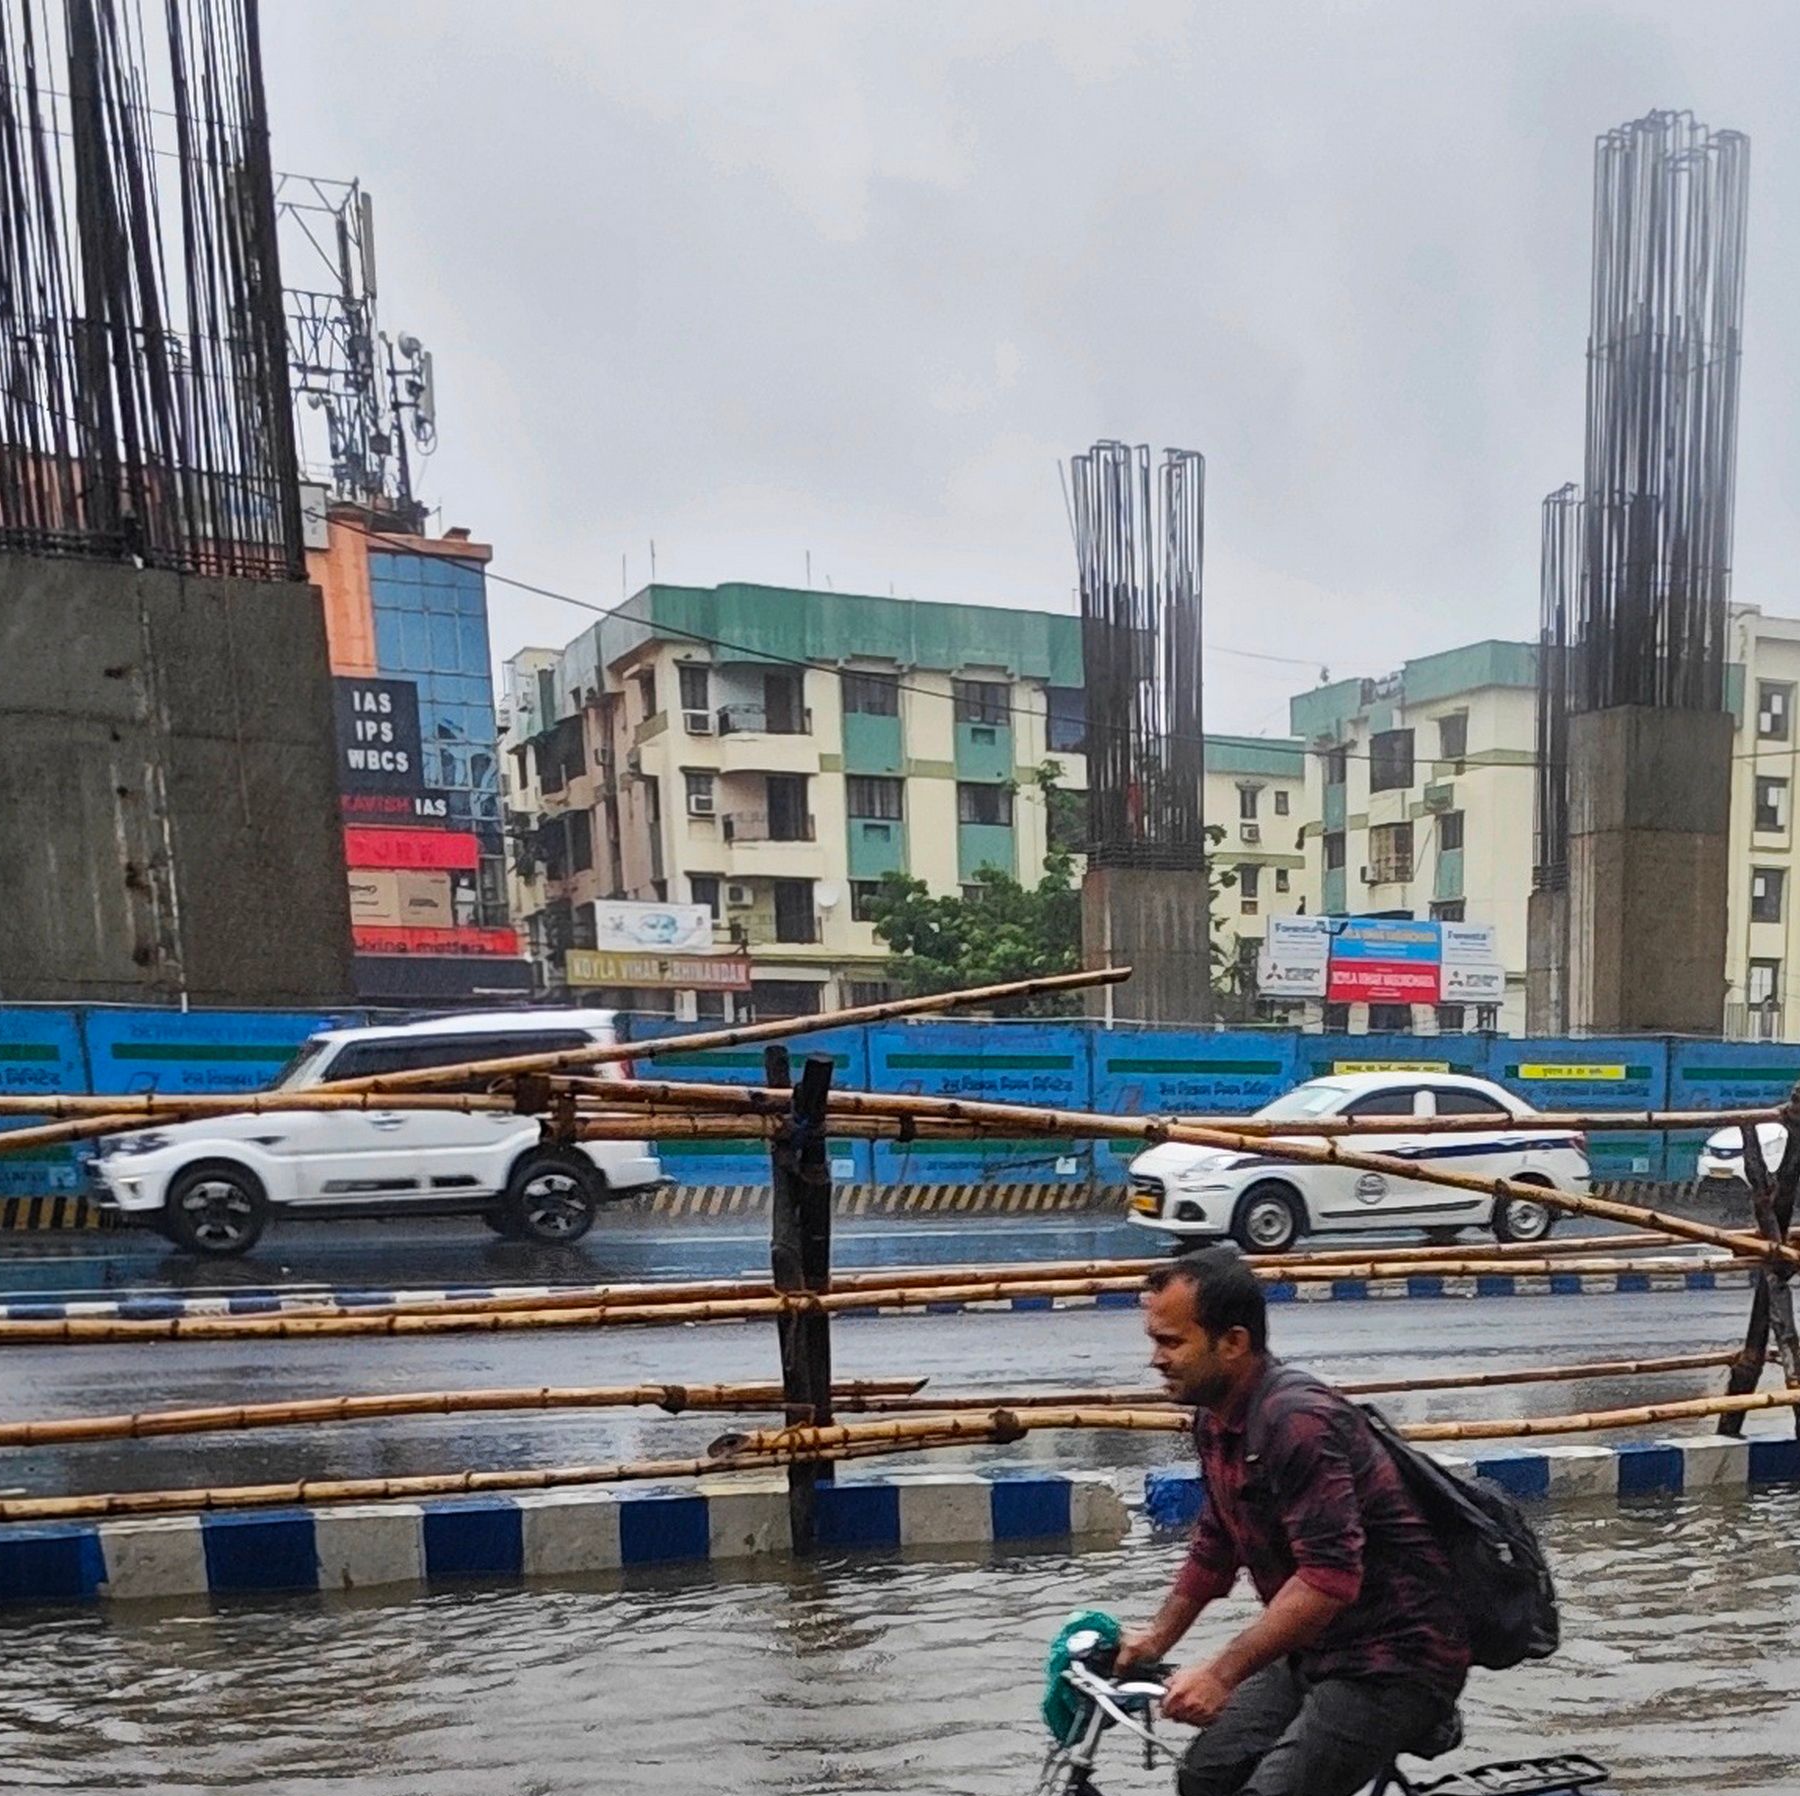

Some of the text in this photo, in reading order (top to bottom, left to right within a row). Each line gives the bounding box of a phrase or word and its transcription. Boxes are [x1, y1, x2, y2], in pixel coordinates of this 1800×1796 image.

[353, 691, 392, 713] IAS
[356, 720, 394, 743] IPS
[347, 749, 409, 772] WBCS
[415, 798, 447, 817] IAS
[573, 958, 616, 979] KOYLA
